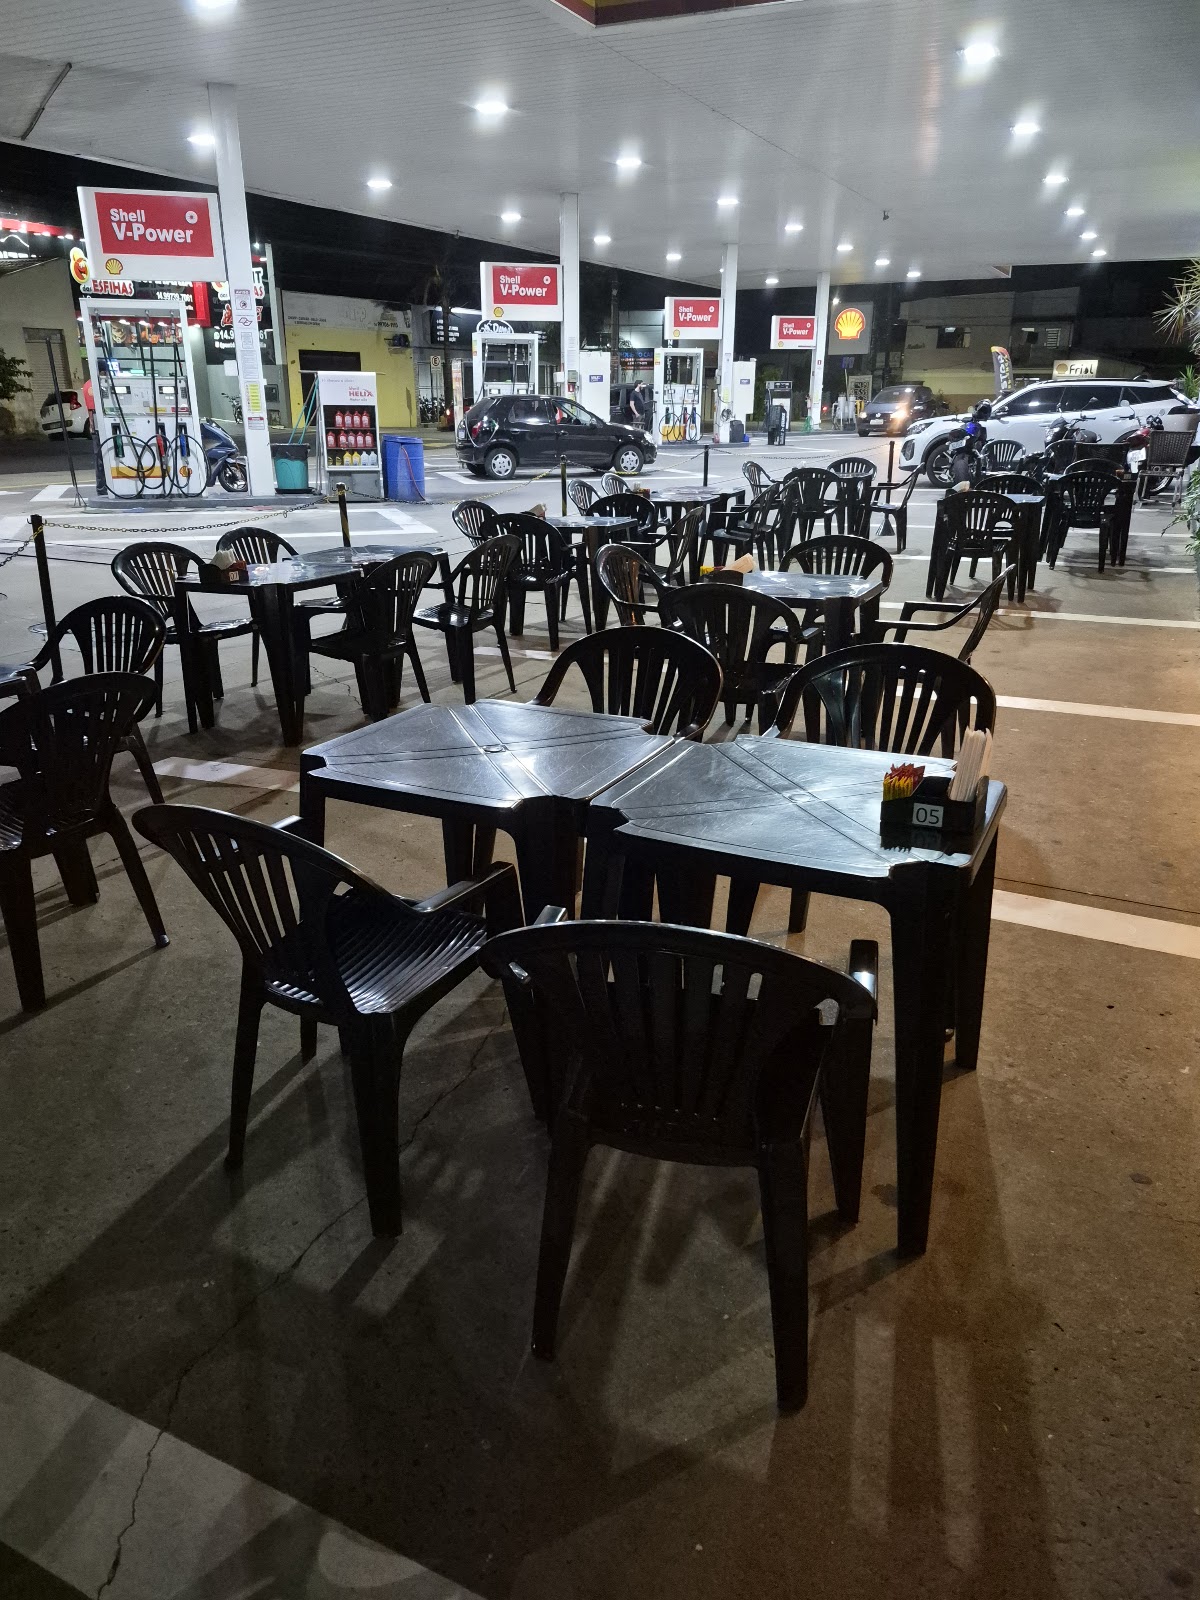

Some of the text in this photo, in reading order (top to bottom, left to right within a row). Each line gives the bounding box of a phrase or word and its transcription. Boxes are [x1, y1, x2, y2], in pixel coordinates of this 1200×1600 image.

[110, 208, 146, 222] Shell
[111, 222, 193, 243] V-Power
[500, 275, 521, 284] Shell
[91, 280, 133, 296] ESFIHAS
[500, 284, 548, 297] V-Power
[679, 312, 712, 322] V-Power
[348, 389, 373, 397] HELIX
[916, 807, 940, 825] 05
